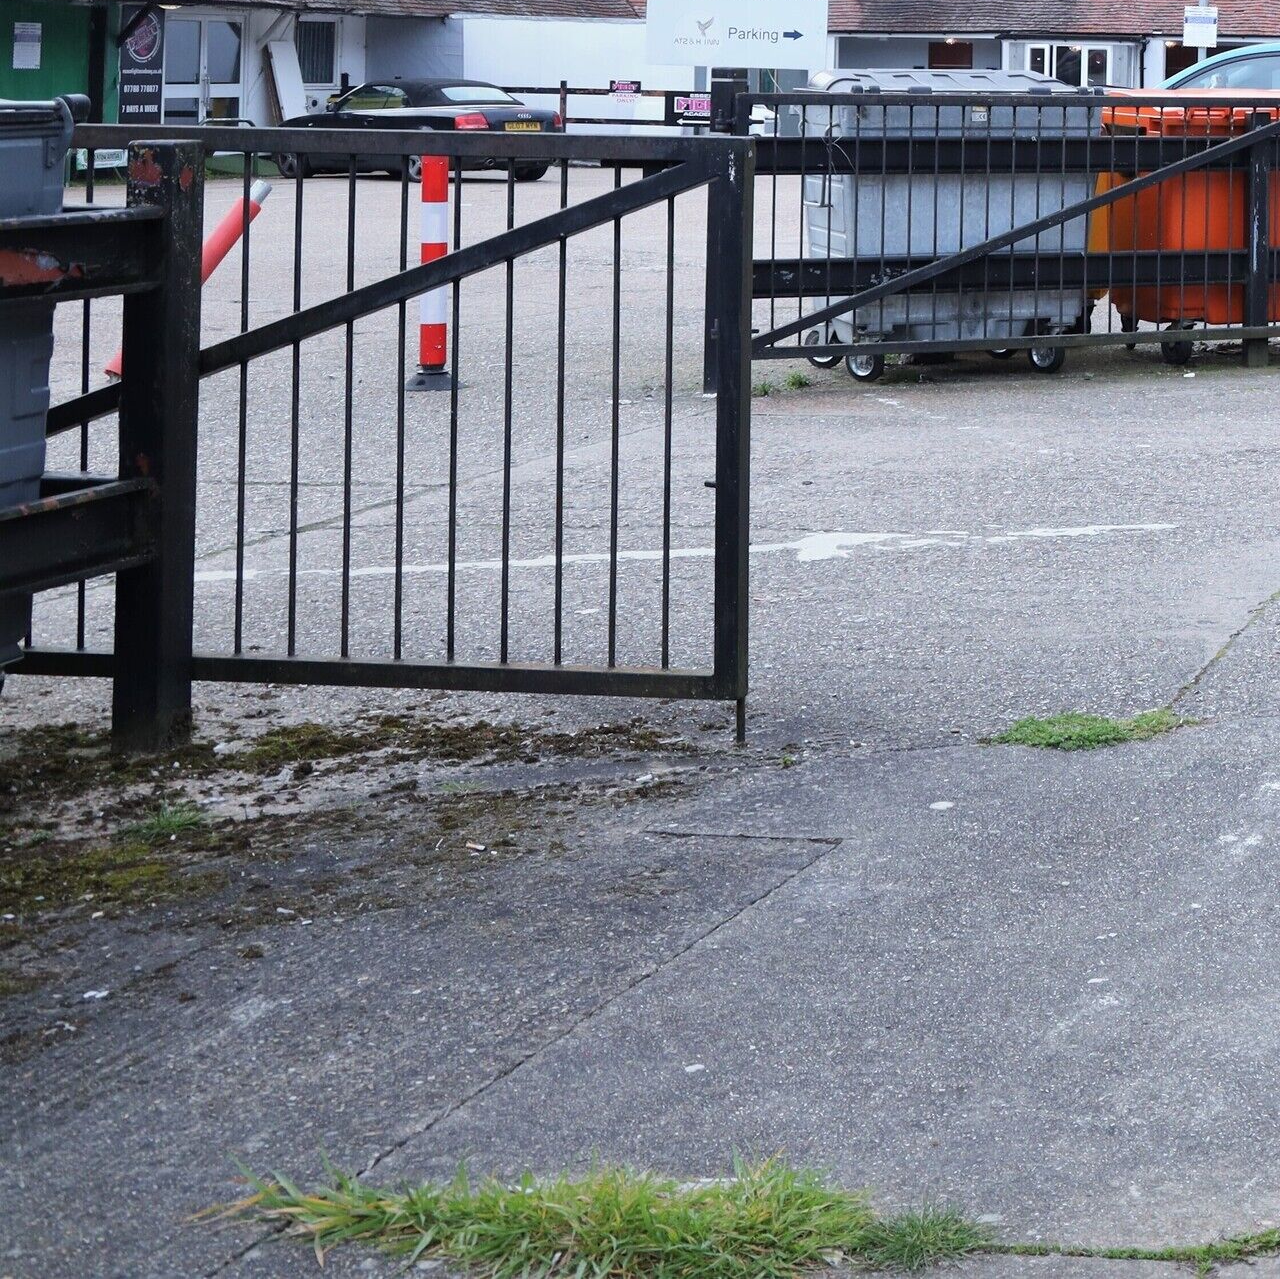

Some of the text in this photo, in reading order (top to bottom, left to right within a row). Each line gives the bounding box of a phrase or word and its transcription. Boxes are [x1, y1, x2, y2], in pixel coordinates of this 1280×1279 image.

[728, 27, 778, 43] Parking
[122, 105, 125, 113] 7
[126, 105, 139, 113] DAYS
[139, 105, 144, 113] A
